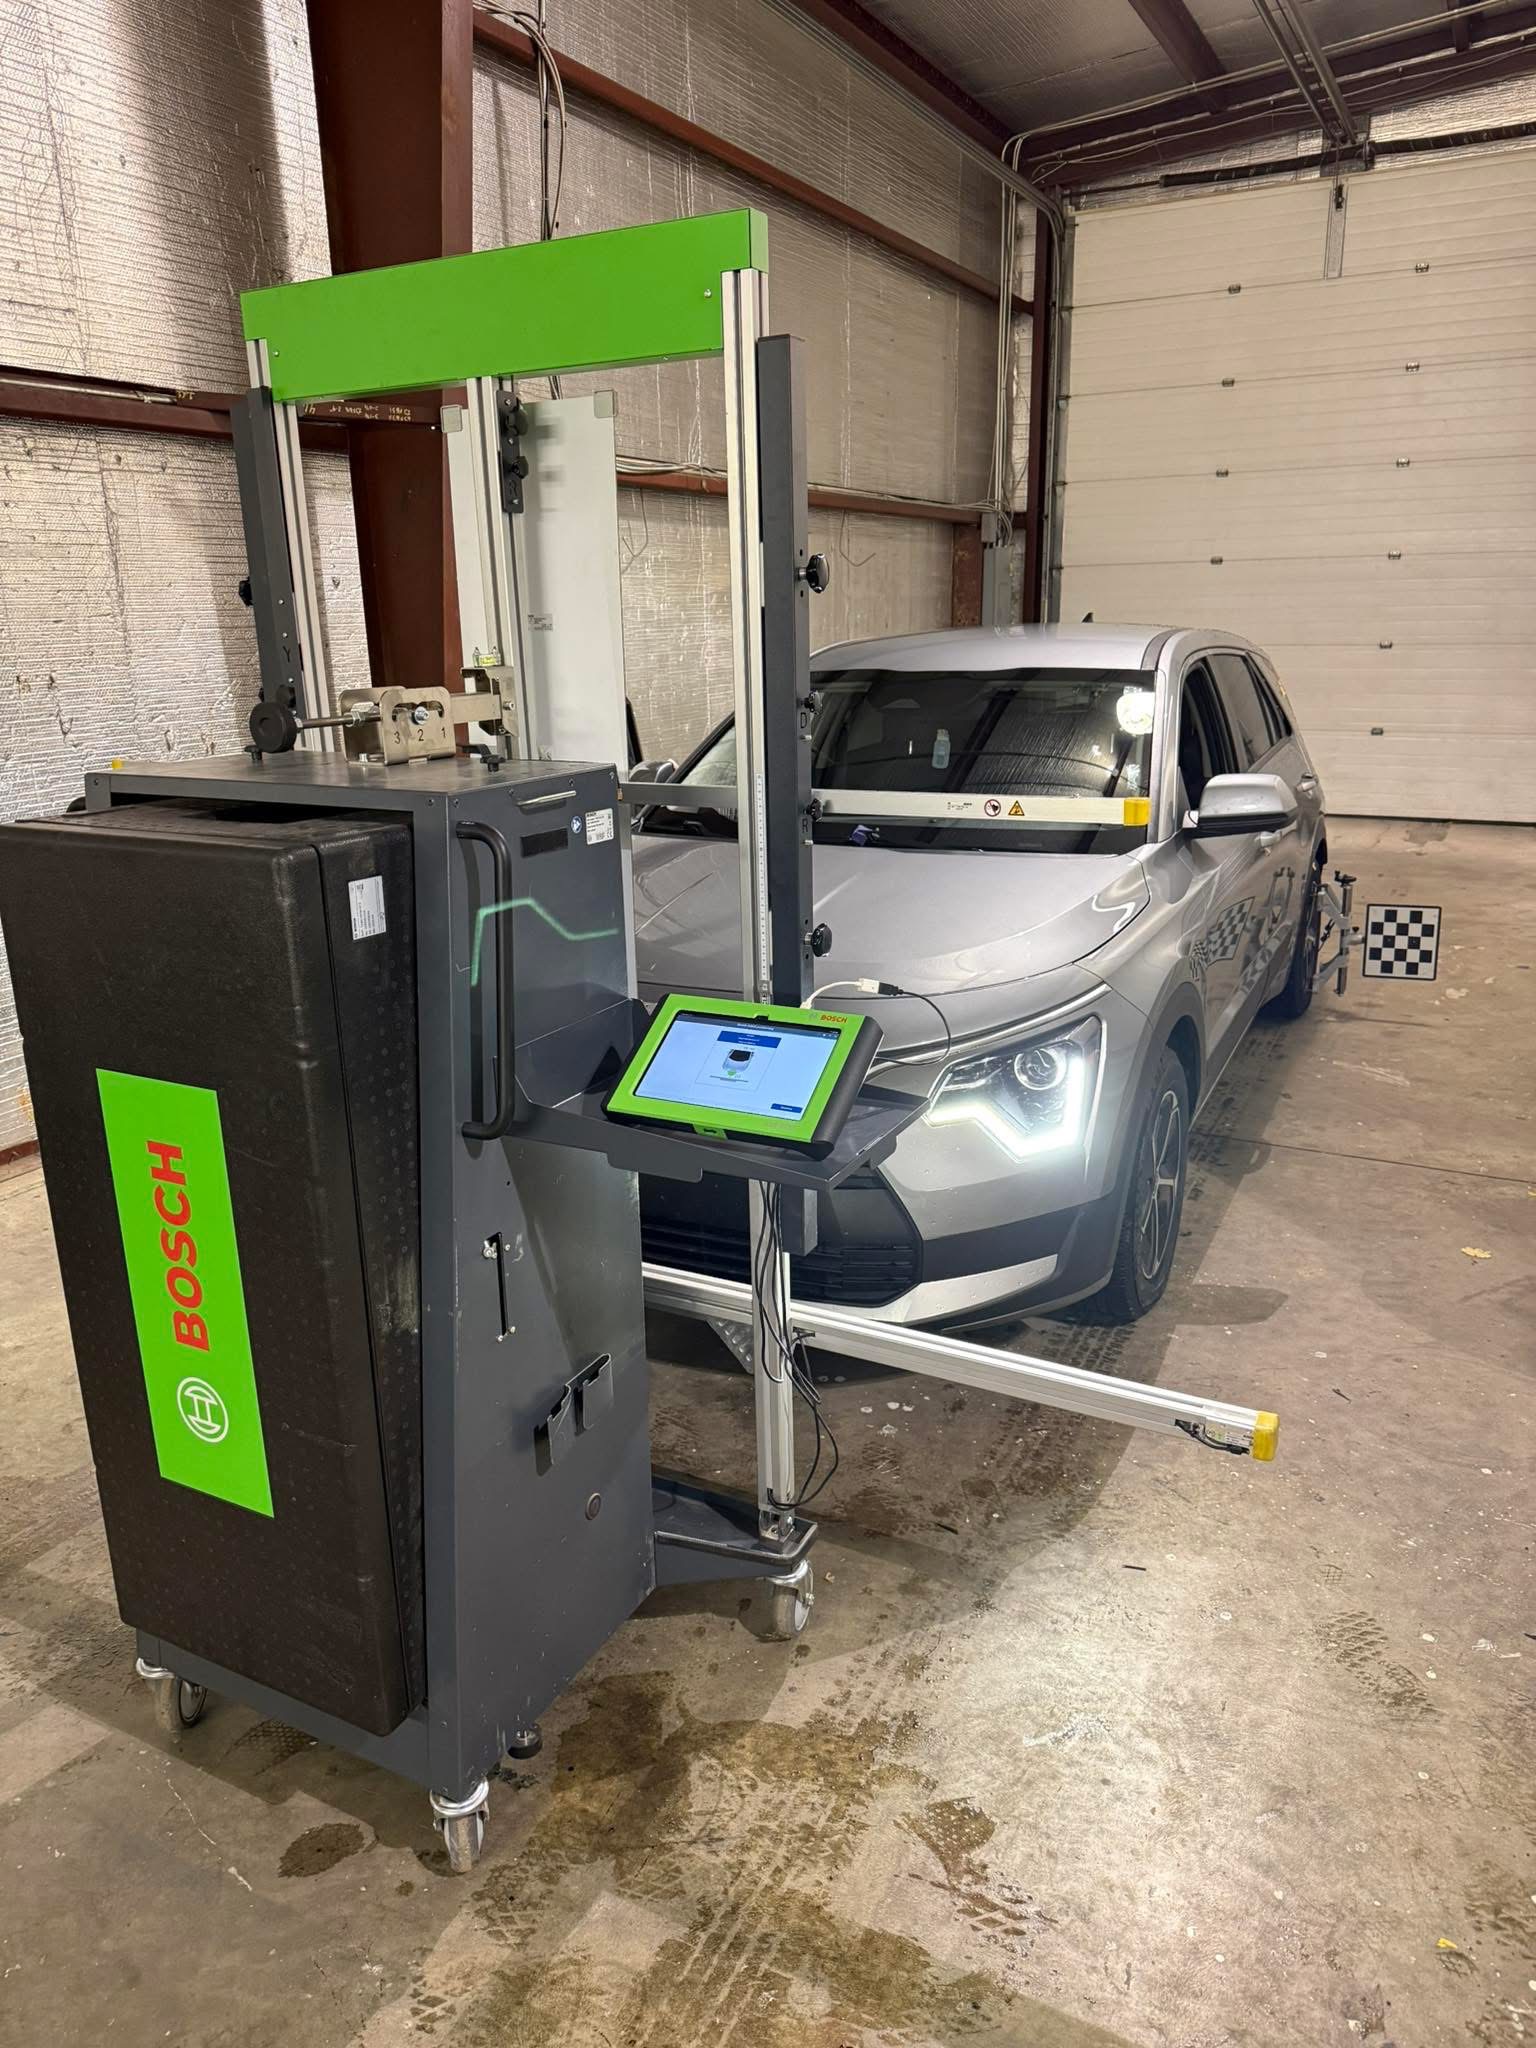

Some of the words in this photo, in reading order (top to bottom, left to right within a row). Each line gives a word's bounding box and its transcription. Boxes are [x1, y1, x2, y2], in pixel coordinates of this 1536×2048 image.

[800, 711, 808, 729] D
[393, 731, 401, 745] 3
[417, 728, 425, 742] 2
[441, 726, 447, 739] 1
[801, 817, 809, 833] R
[820, 1013, 848, 1024] BOSCH
[146, 1140, 210, 1352] BOSCH
